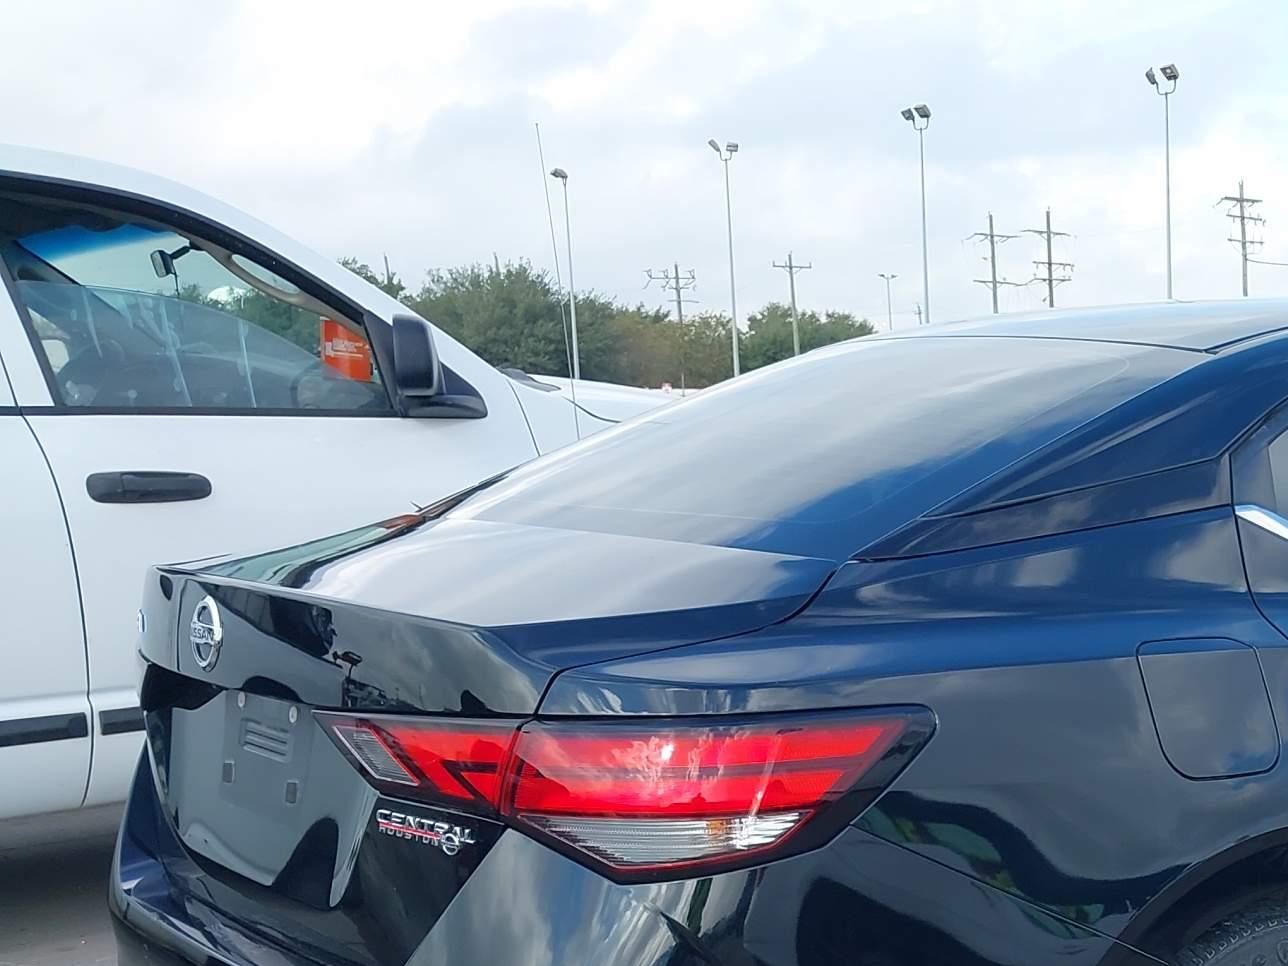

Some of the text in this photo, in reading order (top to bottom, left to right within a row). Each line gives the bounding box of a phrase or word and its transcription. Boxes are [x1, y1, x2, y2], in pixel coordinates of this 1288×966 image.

[191, 625, 214, 641] SSAN
[376, 809, 476, 844] CENTRAL
[379, 823, 440, 847] HOUSTON
